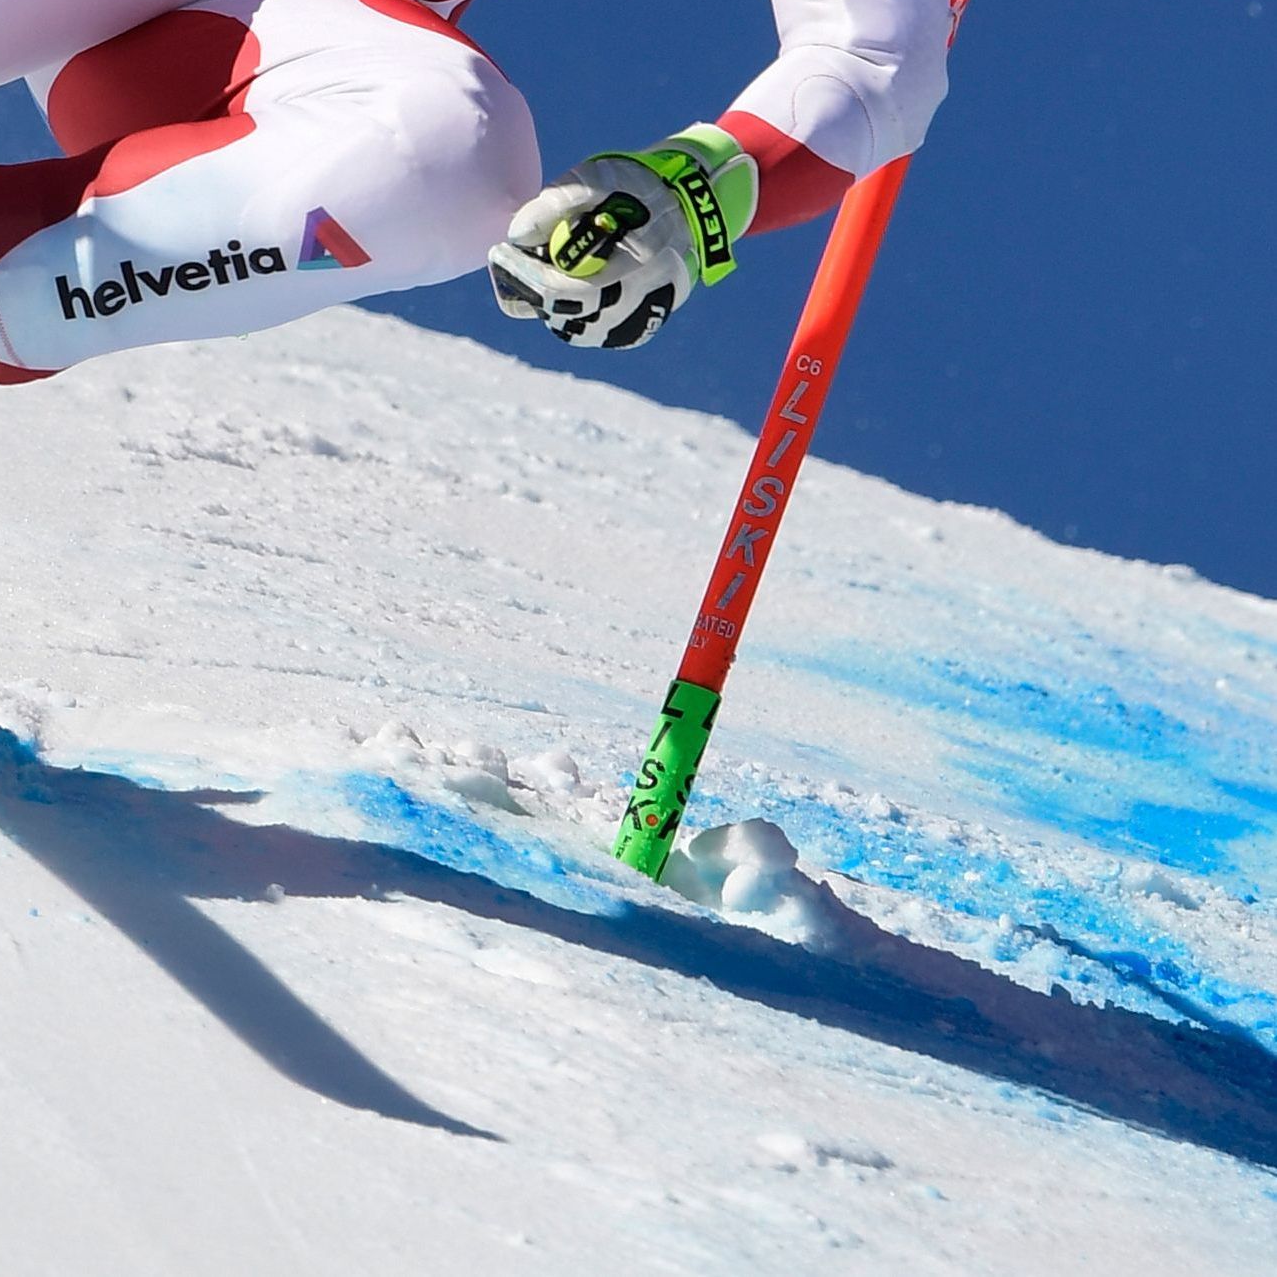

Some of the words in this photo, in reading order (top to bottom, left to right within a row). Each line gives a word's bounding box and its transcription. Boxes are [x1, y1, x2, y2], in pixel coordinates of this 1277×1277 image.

[559, 230, 595, 269] LEKI
[688, 178, 733, 253] LEKI
[55, 239, 288, 321] helvetia
[796, 354, 822, 376] C6
[717, 379, 811, 611] LISKI
